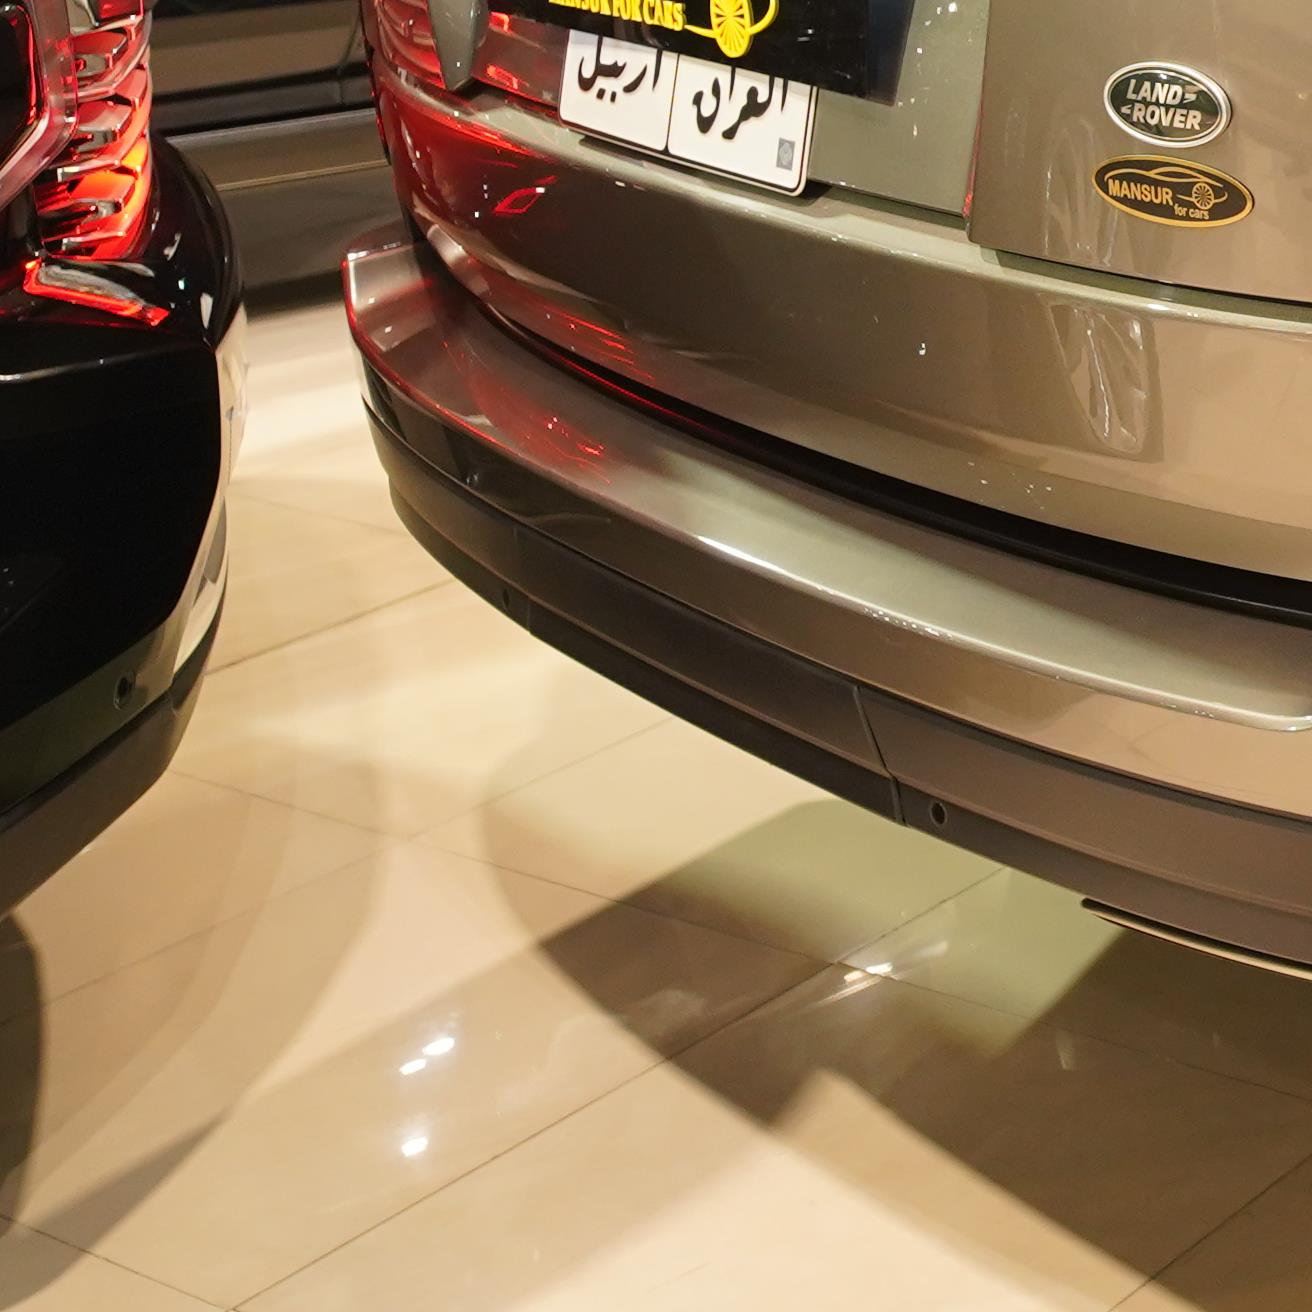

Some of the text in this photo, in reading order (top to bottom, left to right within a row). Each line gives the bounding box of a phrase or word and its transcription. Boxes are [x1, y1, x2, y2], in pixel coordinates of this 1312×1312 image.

[1127, 79, 1182, 105] LAND
[1133, 105, 1201, 130] ROVER
[1108, 179, 1173, 206] MANSUR
[1174, 203, 1209, 219] for cars
